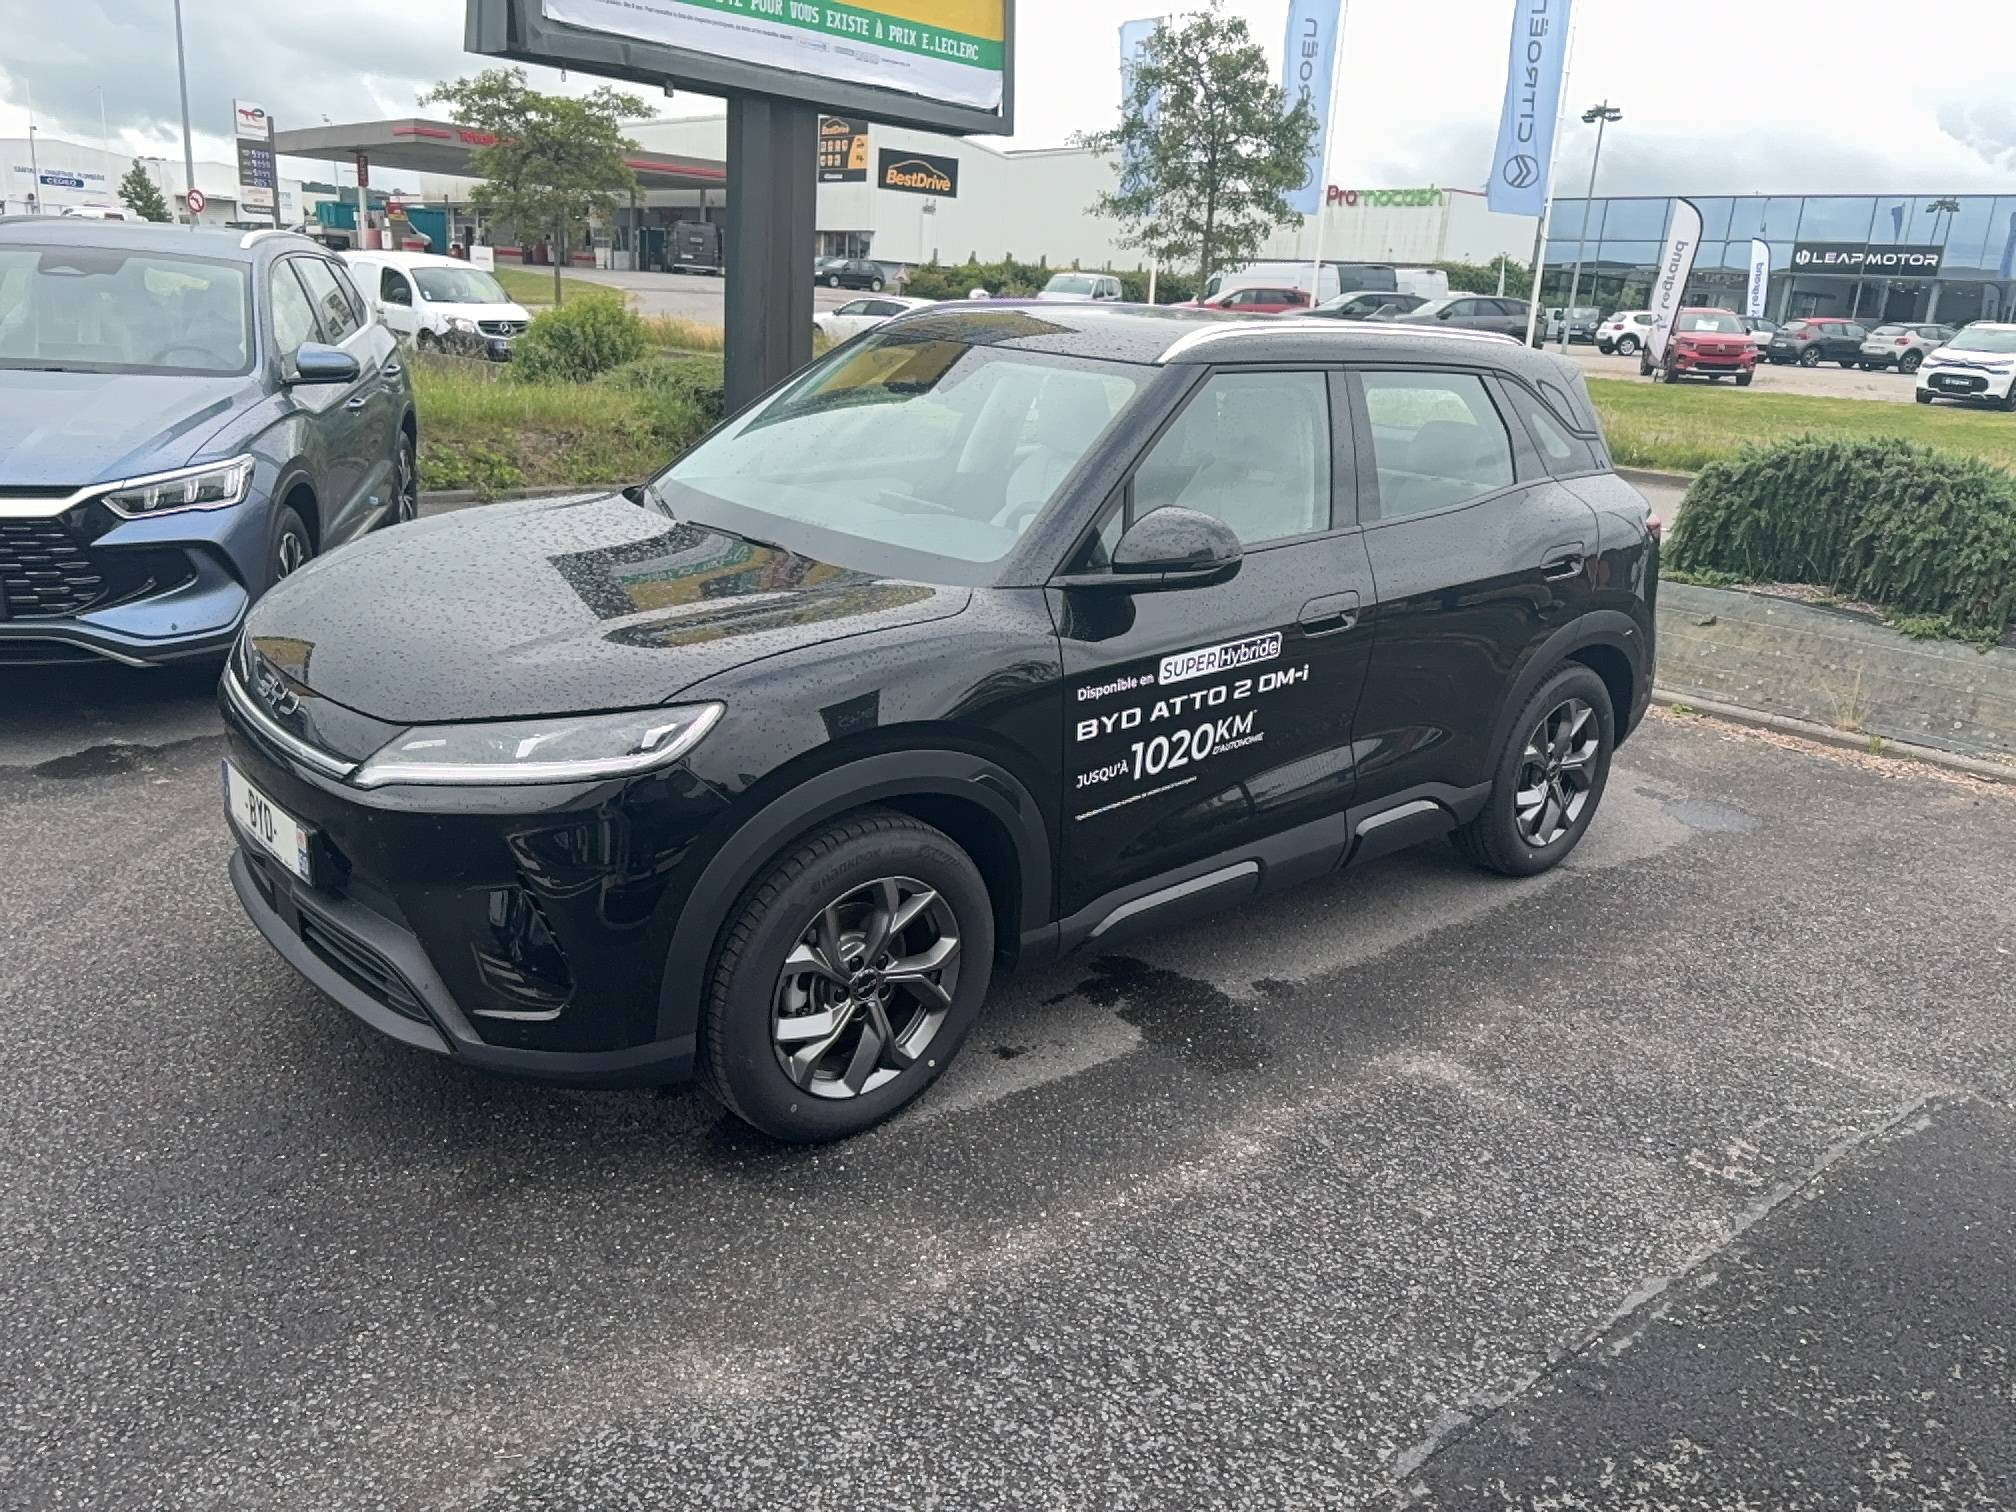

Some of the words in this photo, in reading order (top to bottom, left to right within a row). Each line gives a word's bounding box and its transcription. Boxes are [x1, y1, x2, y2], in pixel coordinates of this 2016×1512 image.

[790, 1, 819, 24] VOUS
[826, 10, 869, 35] EXISTE
[875, 15, 883, 39] À
[889, 25, 916, 47] PRIX
[922, 33, 979, 61] E.LECLERC
[886, 168, 951, 191] BestDrive
[1811, 251, 1939, 267] LEAPMOTOR
[1077, 676, 1138, 701] Disponible
[1140, 674, 1154, 686] en
[1076, 707, 1142, 742] BYD
[1150, 685, 1228, 722] ATTO
[1233, 679, 1253, 700] 2
[1258, 664, 1310, 693] DM-i
[1075, 759, 1129, 789] JUSQU'À
